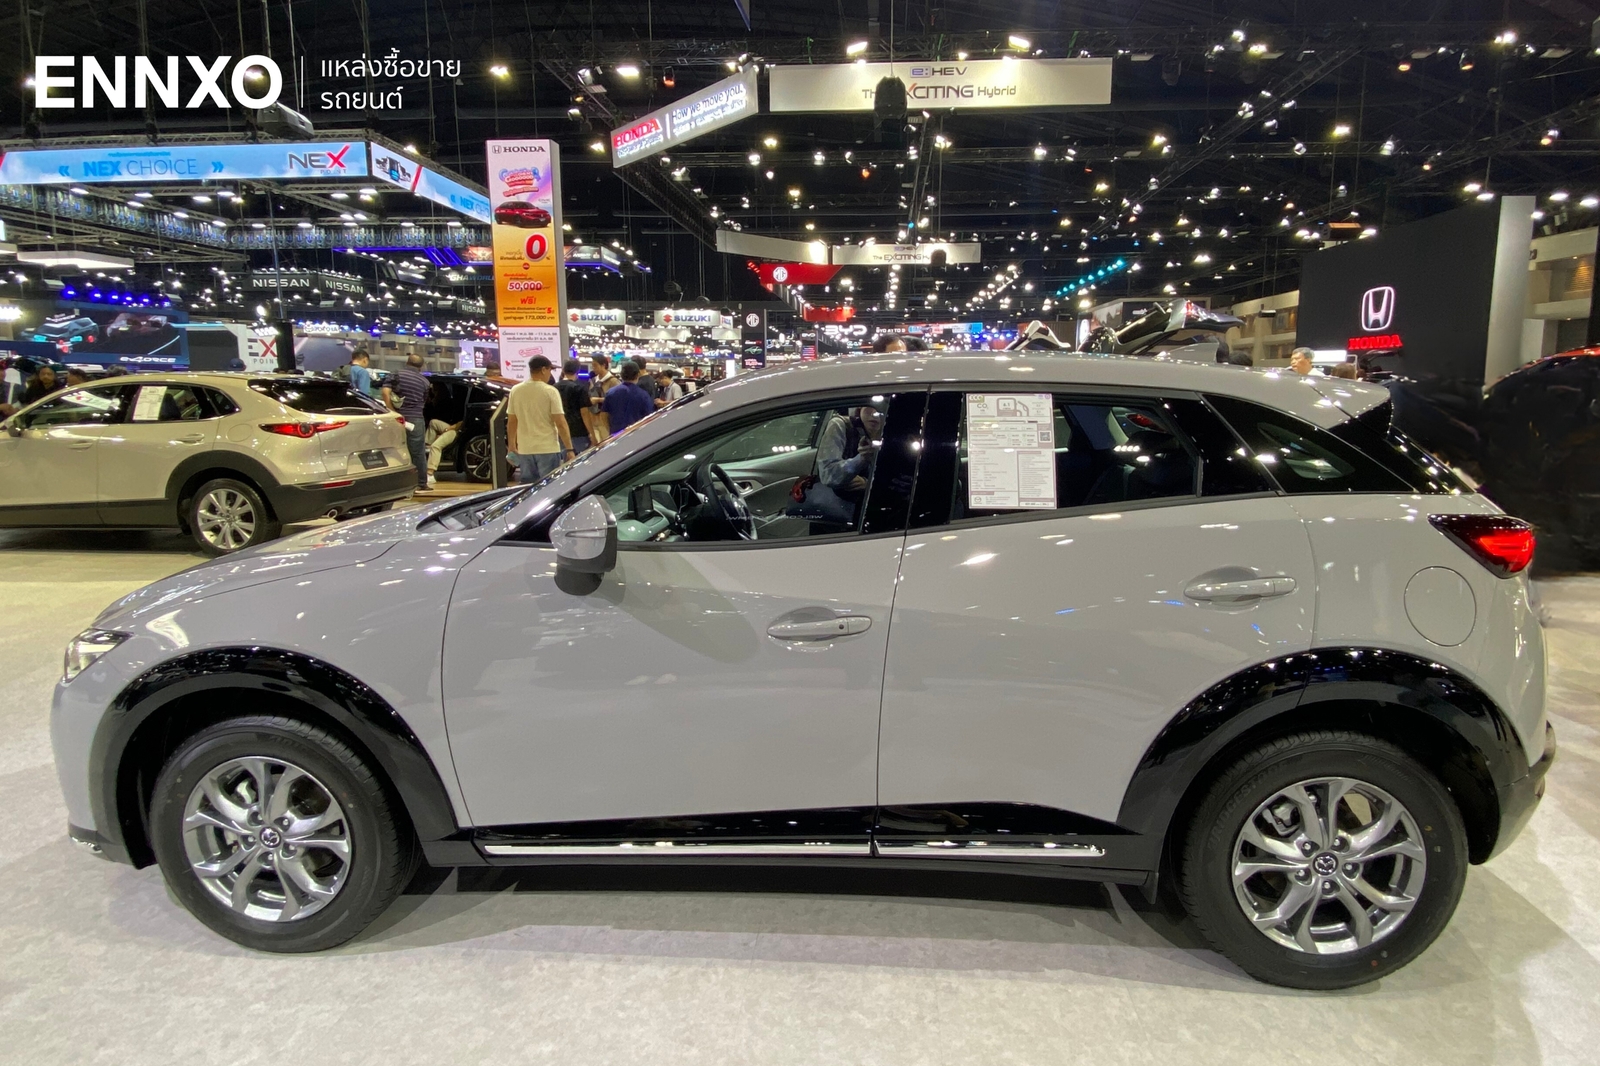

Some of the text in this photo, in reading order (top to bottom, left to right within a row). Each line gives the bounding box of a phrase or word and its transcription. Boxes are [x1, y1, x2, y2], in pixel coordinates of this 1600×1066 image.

[862, 83, 1017, 99] Th XCITING Hybrid
[672, 107, 688, 121] How
[688, 102, 701, 115] we
[702, 92, 724, 109] move
[613, 117, 661, 148] HONDA
[288, 144, 351, 170] NEX
[82, 158, 198, 177] NEX CHOICE
[525, 233, 547, 261] 0
[252, 278, 310, 288] NISSAN
[325, 280, 364, 294] NISSAN
[508, 281, 543, 292] 50,000
[461, 303, 486, 315] NISSAN
[674, 314, 711, 322] SUZUKI
[824, 324, 867, 336] BYD
[247, 338, 277, 358] EX
[1347, 334, 1403, 350] HONDA
